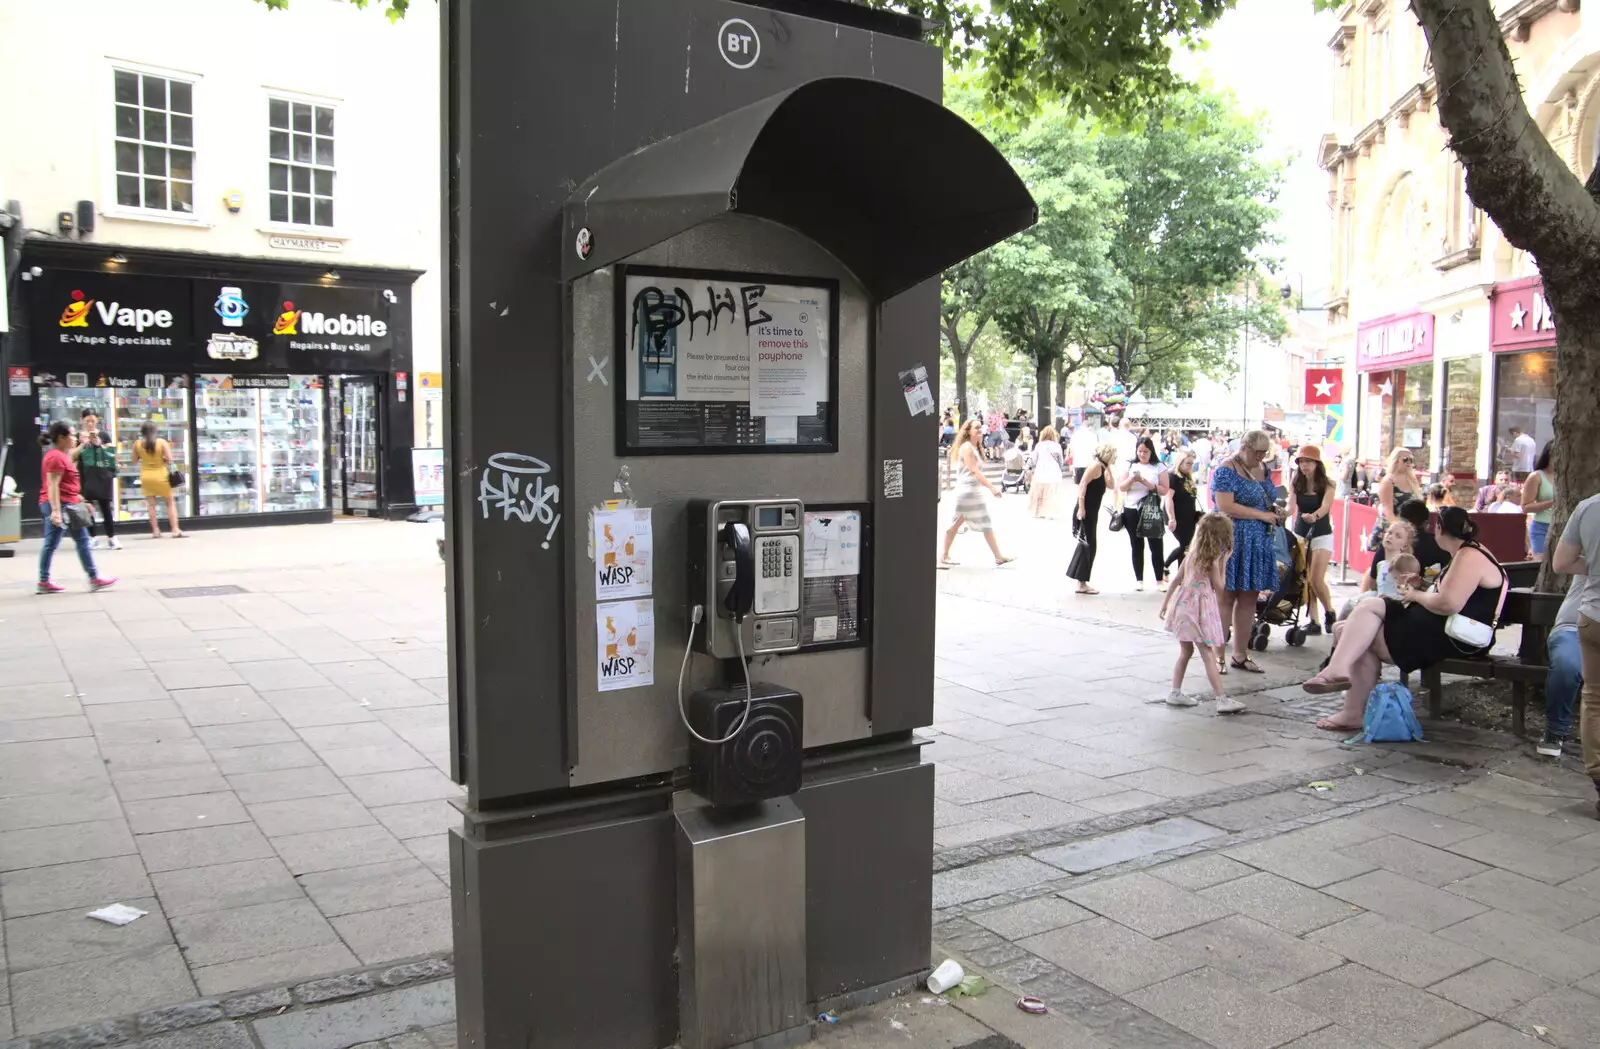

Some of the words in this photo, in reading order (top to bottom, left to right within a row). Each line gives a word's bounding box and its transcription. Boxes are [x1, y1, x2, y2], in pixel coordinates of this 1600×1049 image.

[728, 33, 751, 54] BT
[274, 238, 325, 249] HAYMARKET
[301, 312, 387, 337] Mobile
[758, 325, 771, 336] It's
[773, 326, 792, 336] time
[794, 327, 803, 336] to
[60, 334, 106, 345] E-Vape
[109, 335, 172, 346] Specialist
[758, 340, 792, 348] remove
[793, 339, 808, 348] this
[290, 341, 323, 351] Repairs
[331, 342, 347, 352] Buy
[354, 343, 371, 351] Sell
[686, 352, 704, 360] Please
[713, 353, 739, 362] prepared
[758, 351, 803, 362] payphone
[232, 378, 245, 387] BUY
[250, 378, 266, 387] SELL
[600, 566, 633, 585] WASP
[602, 657, 635, 677] WASP
